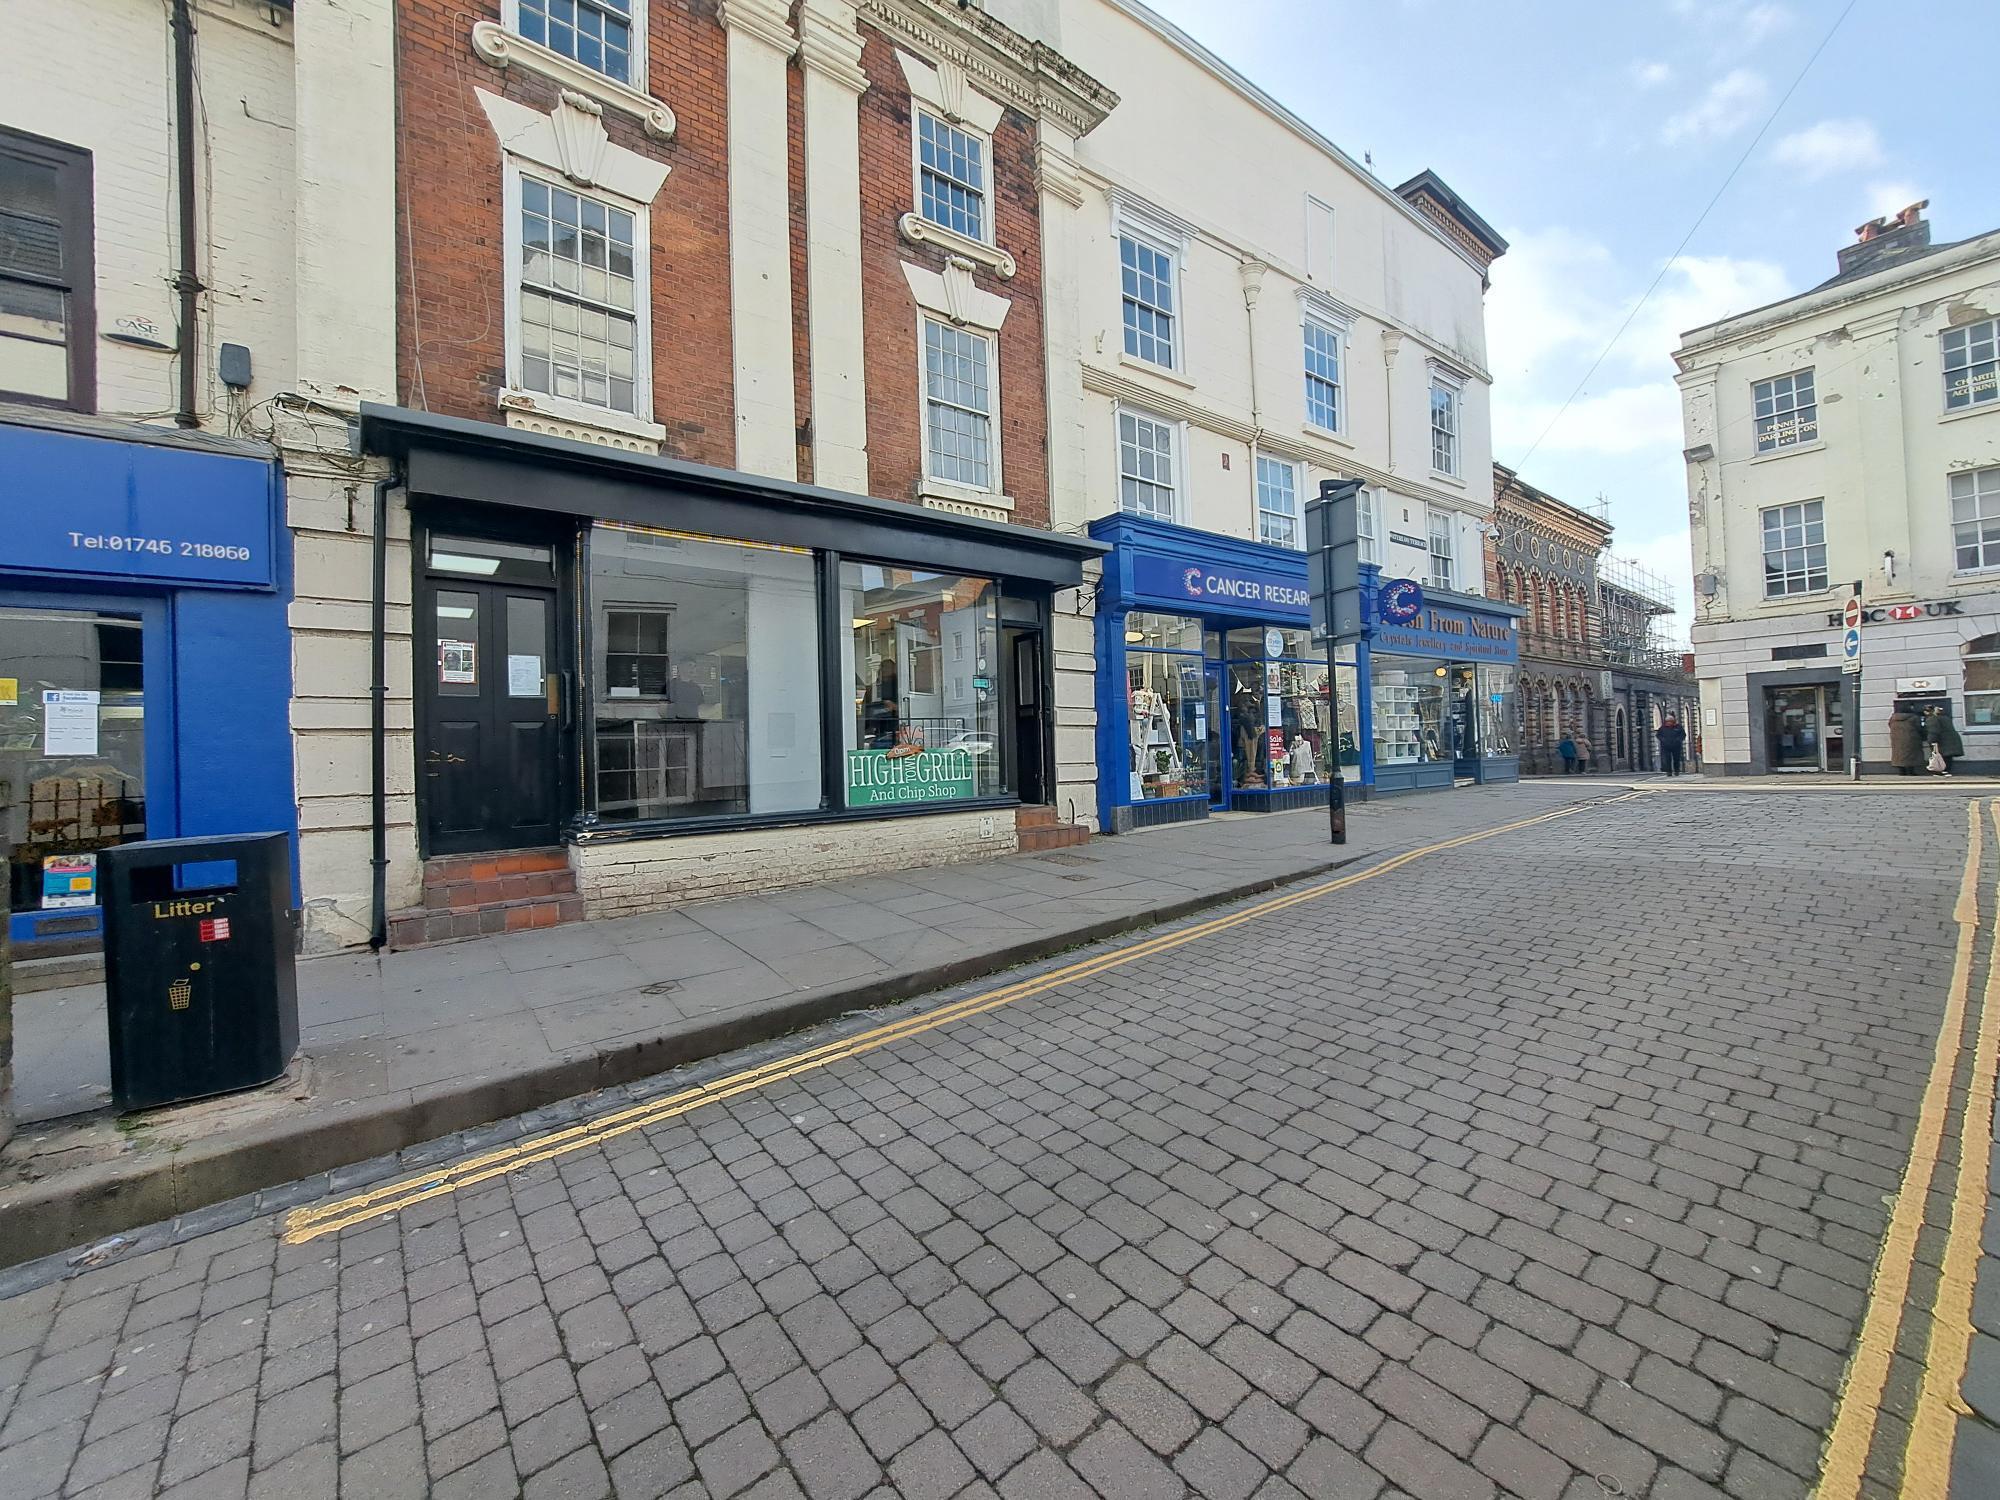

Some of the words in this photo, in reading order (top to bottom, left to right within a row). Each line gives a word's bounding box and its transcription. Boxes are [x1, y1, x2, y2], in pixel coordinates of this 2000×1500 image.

[116, 318, 160, 335] CASE
[1206, 576, 1261, 599] CANCER
[1264, 585, 1310, 606] RESEAR
[1428, 609, 1465, 635] From
[1470, 617, 1510, 641] Nature
[1827, 608, 1886, 627] HBC
[1924, 601, 1964, 617] UK
[849, 754, 906, 787] HIGH
[916, 751, 972, 783] GRILL
[870, 787, 896, 802] And
[898, 785, 926, 801] Chip
[928, 783, 957, 799] Shop
[154, 900, 215, 919] Litter
